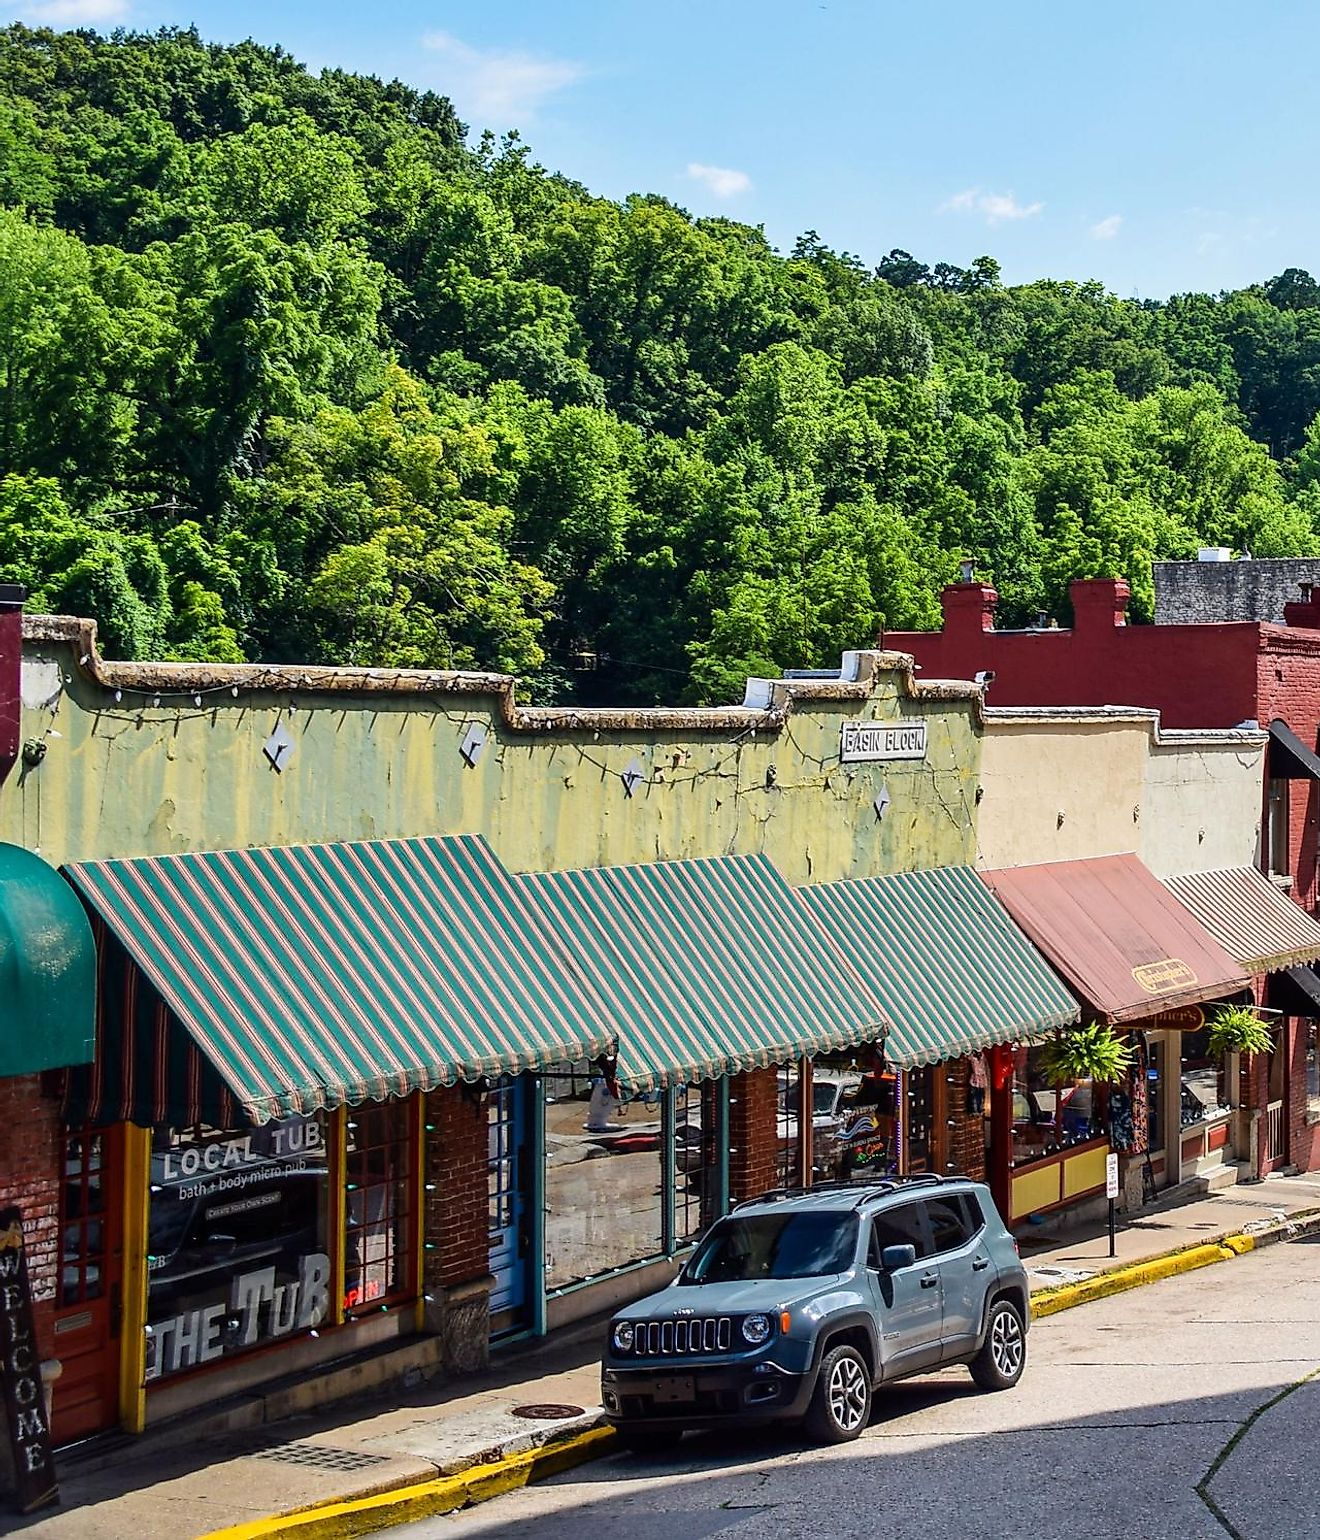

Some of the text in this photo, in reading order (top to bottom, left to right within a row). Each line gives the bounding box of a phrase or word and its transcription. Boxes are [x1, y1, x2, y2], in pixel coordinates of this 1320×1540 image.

[844, 730, 924, 753] BASIN BLOCK
[163, 1136, 257, 1180] LOCAL
[179, 1180, 207, 1201] bath
[219, 1169, 246, 1190] body
[249, 1166, 283, 1184] micro
[284, 1159, 307, 1178] pub
[148, 1252, 331, 1378] THE TUB
[0, 1252, 46, 1472] WELCOME
